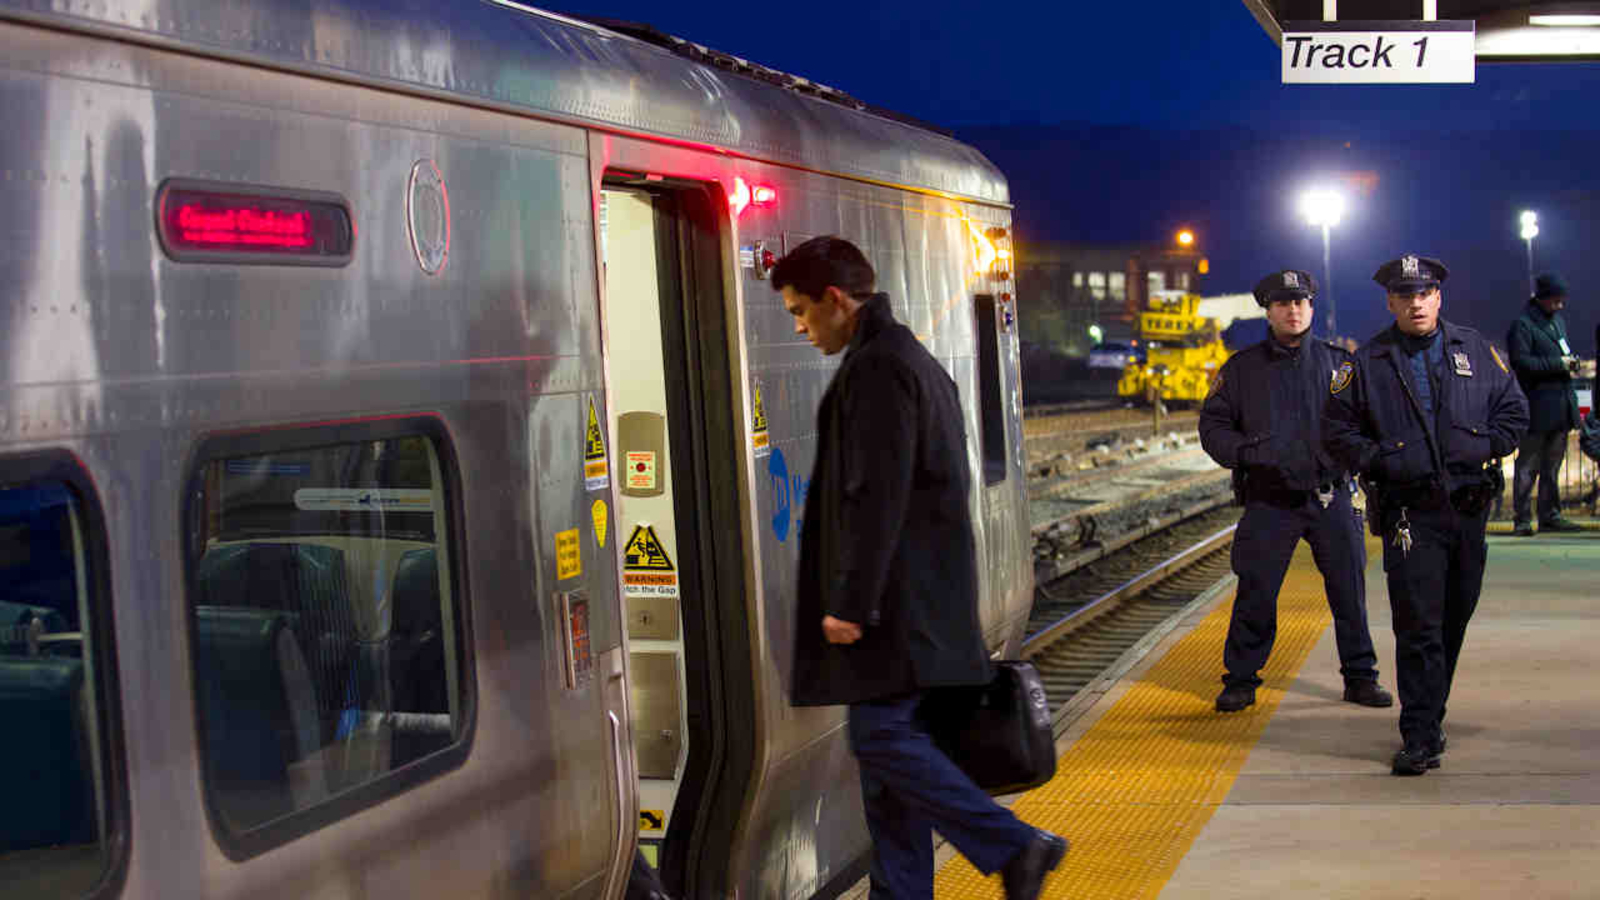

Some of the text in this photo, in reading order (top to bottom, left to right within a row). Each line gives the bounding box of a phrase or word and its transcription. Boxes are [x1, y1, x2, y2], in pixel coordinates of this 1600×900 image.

[1286, 36, 1429, 68] Track 1
[1145, 319, 1196, 331] TEREX
[658, 585, 676, 595] Gap
